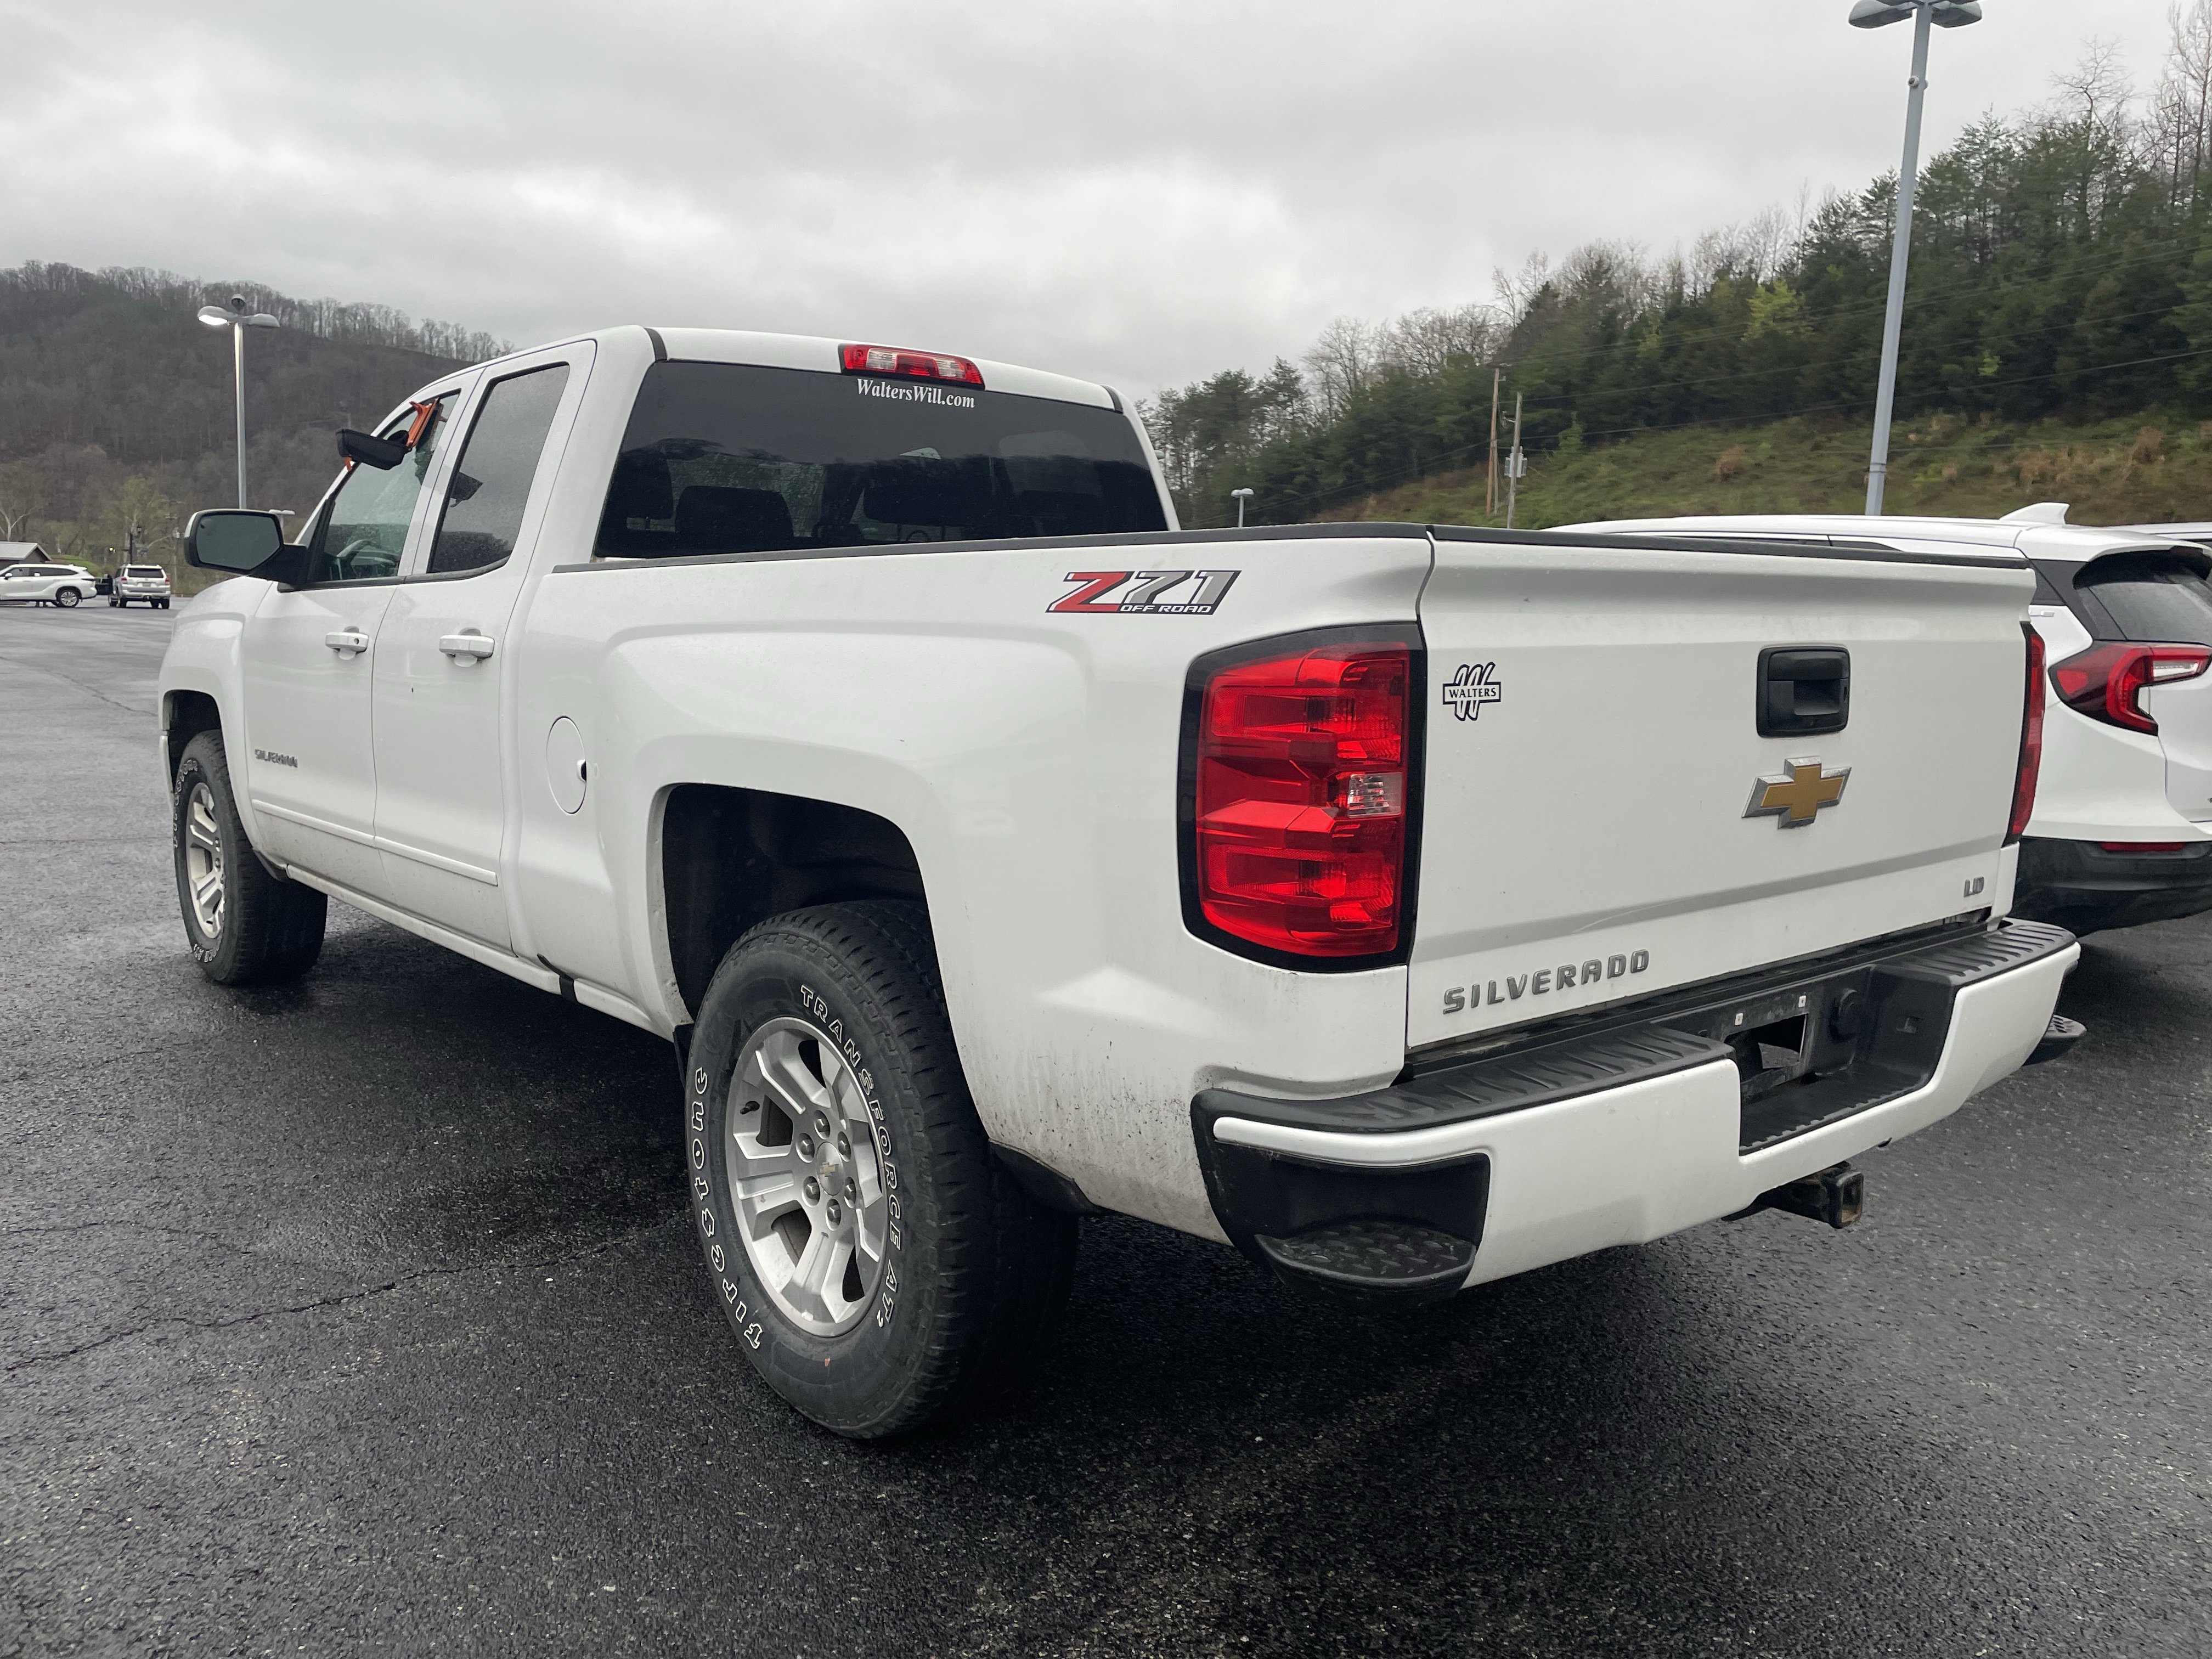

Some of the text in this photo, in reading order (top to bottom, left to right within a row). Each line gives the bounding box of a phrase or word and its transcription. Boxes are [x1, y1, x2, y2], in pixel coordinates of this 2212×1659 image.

[857, 378, 975, 408] WaltersWill.com
[1045, 570, 1243, 616] Z71
[1120, 605, 1212, 613] OFF ROAD
[1448, 688, 1497, 698] WALTERS
[1963, 876, 1984, 898] LD
[1443, 949, 1649, 1015] SILVERADO
[800, 984, 902, 1251] TRANSFORCE
